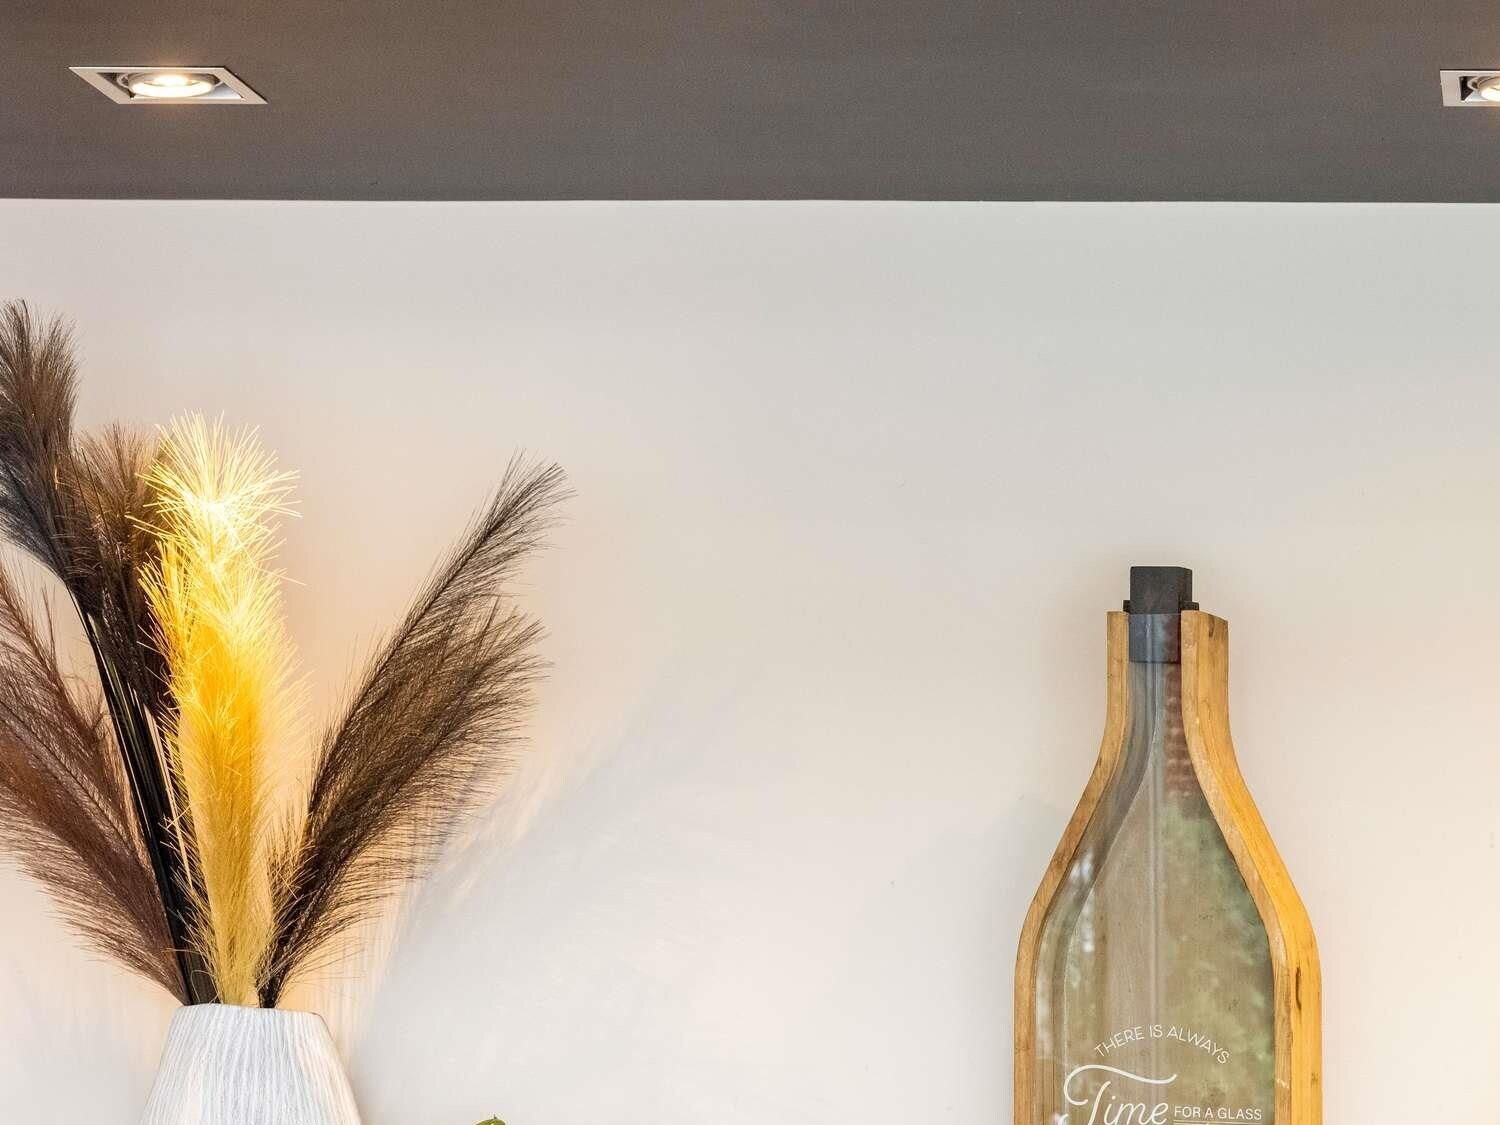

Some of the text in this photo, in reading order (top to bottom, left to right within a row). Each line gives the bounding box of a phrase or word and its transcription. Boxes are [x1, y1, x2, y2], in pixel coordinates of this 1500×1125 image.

[1094, 1024, 1230, 1064] THERE IS ALWAYS
[1174, 1106, 1200, 1118] FOR
[1205, 1107, 1214, 1119] A
[1217, 1108, 1262, 1121] GLASS
